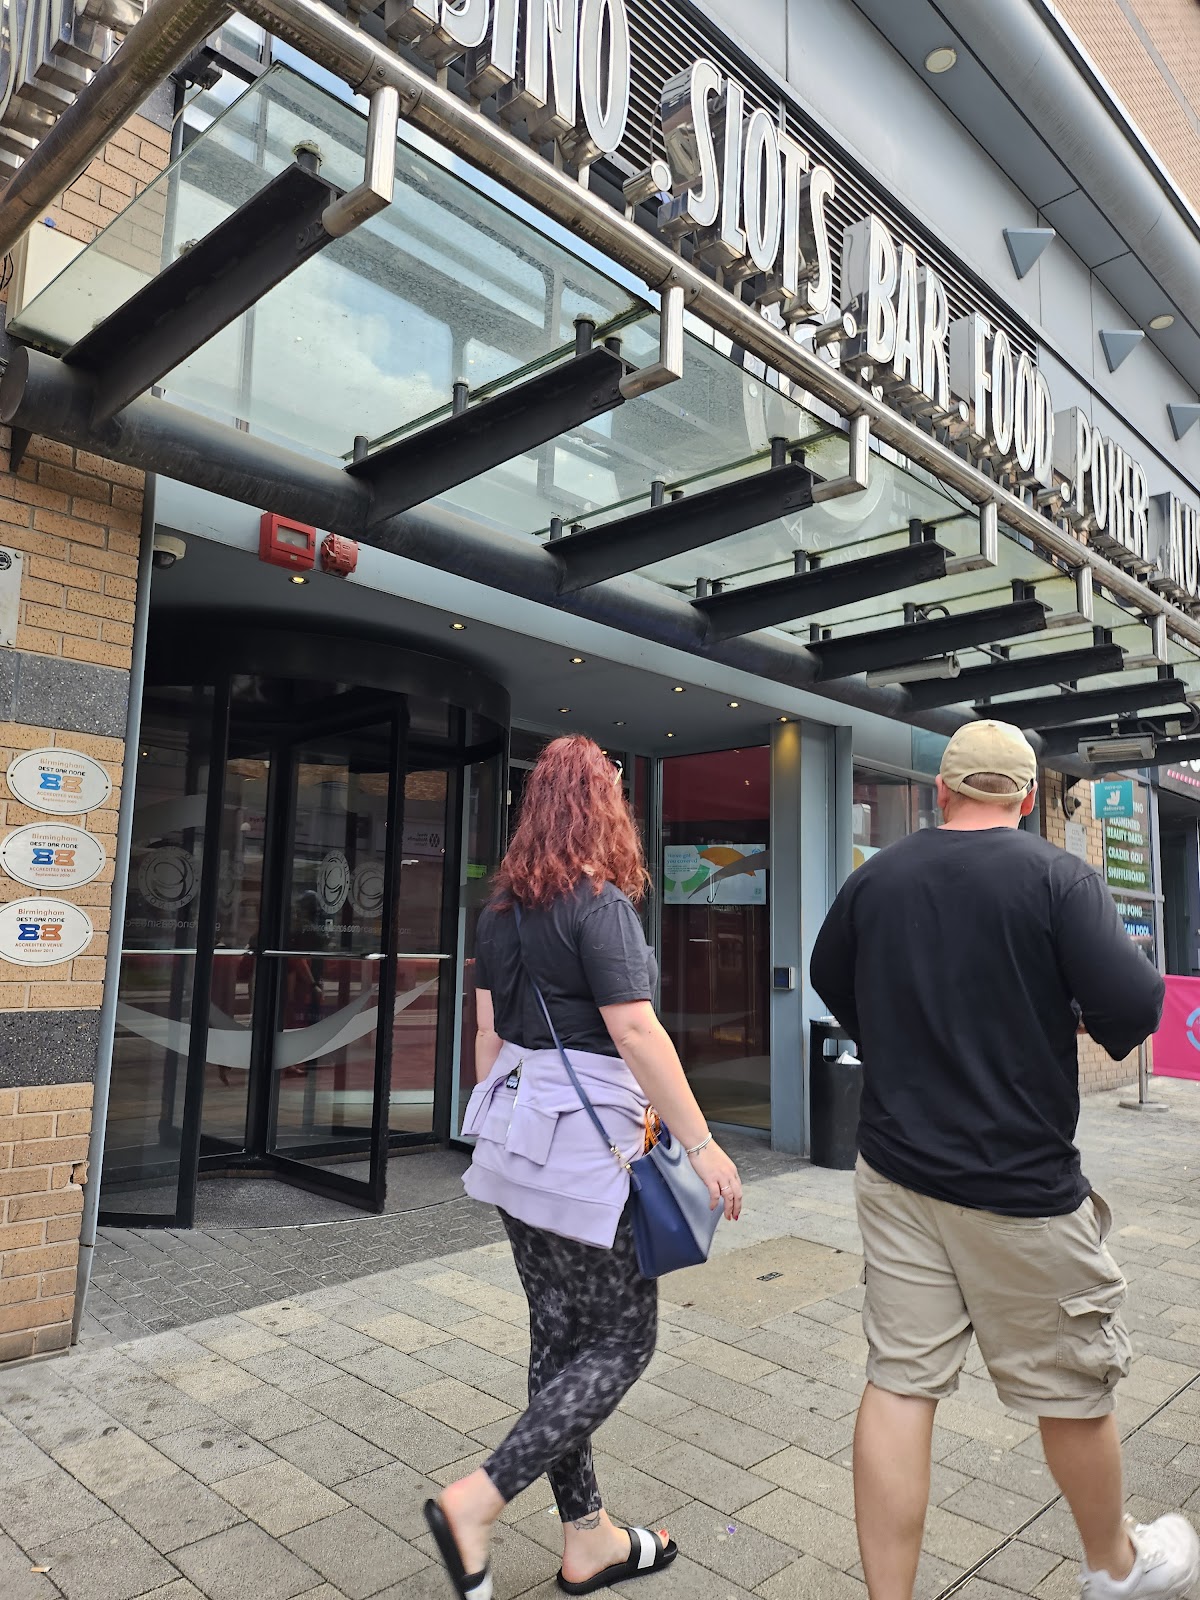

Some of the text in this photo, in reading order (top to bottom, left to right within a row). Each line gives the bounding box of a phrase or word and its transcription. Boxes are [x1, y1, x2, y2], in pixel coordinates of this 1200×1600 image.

[687, 57, 835, 315] SLOTS
[867, 213, 949, 413] BAR
[974, 312, 1055, 490] FOOD
[1076, 406, 1150, 563] POKER
[40, 758, 85, 769] Birmingham
[31, 833, 78, 842] Birmingham
[1107, 826, 1143, 846] REALITY DARTS
[1108, 846, 1143, 864] CRAZIER GOLF
[1108, 866, 1146, 883] SHUFFLEBOARD
[18, 908, 65, 916] Birmingham
[1127, 904, 1143, 918] PONG
[1136, 924, 1150, 937] POOL
